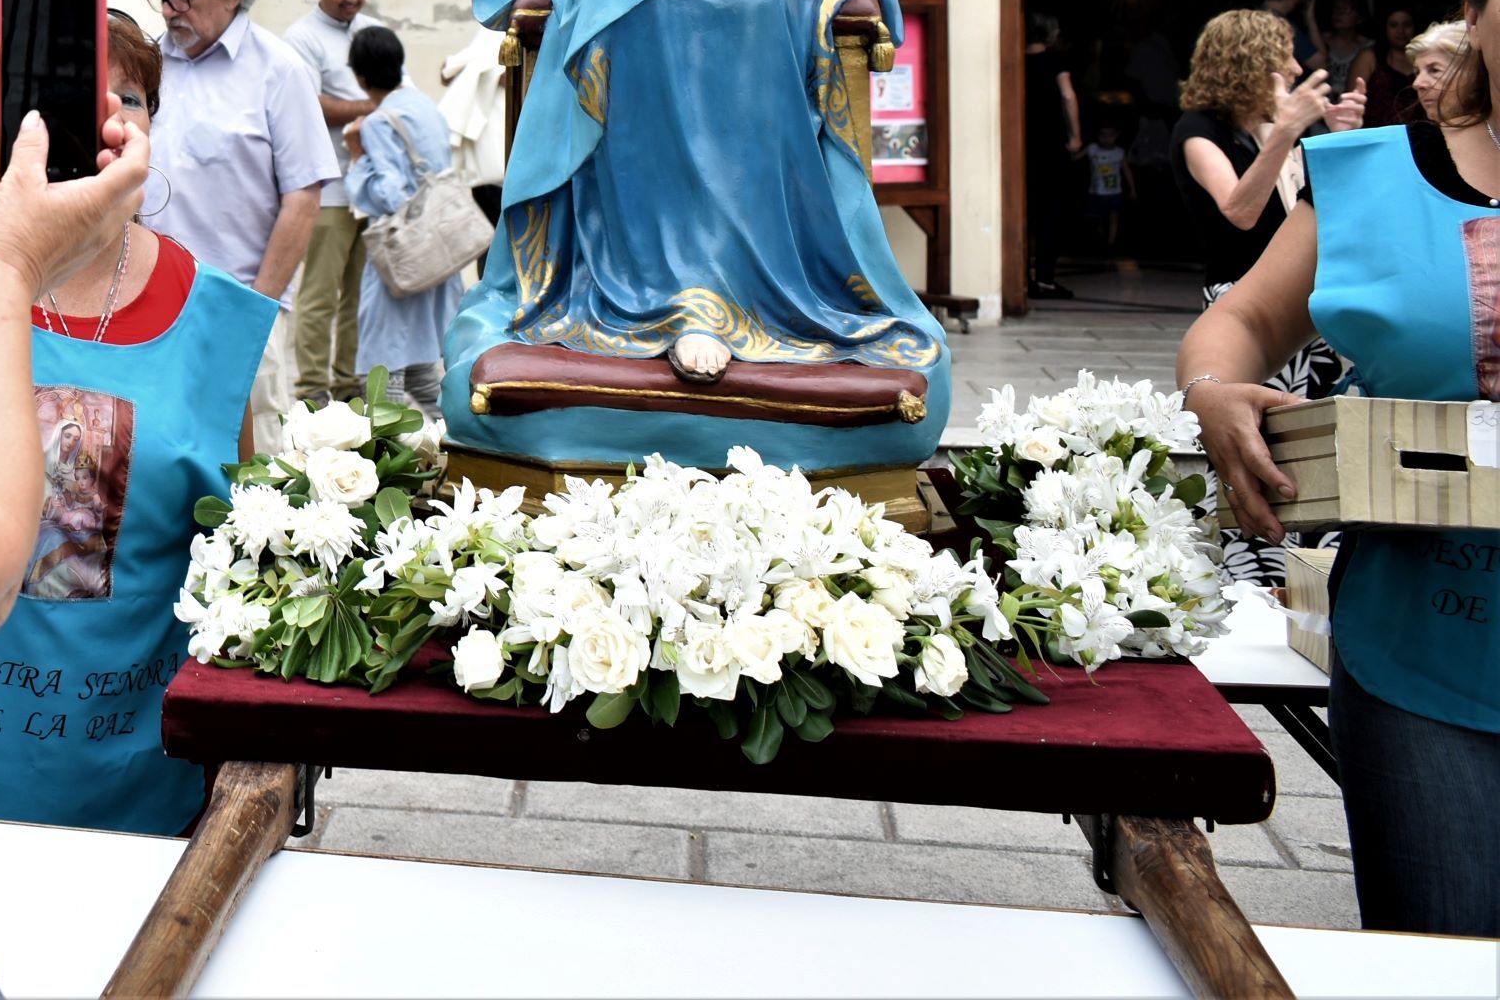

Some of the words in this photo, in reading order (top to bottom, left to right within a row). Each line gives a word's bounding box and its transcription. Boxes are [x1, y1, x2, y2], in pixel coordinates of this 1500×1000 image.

[1431, 588, 1488, 624] DE
[78, 653, 178, 700] SEÑORA
[21, 712, 67, 740] LA
[86, 711, 137, 741] PAZ
